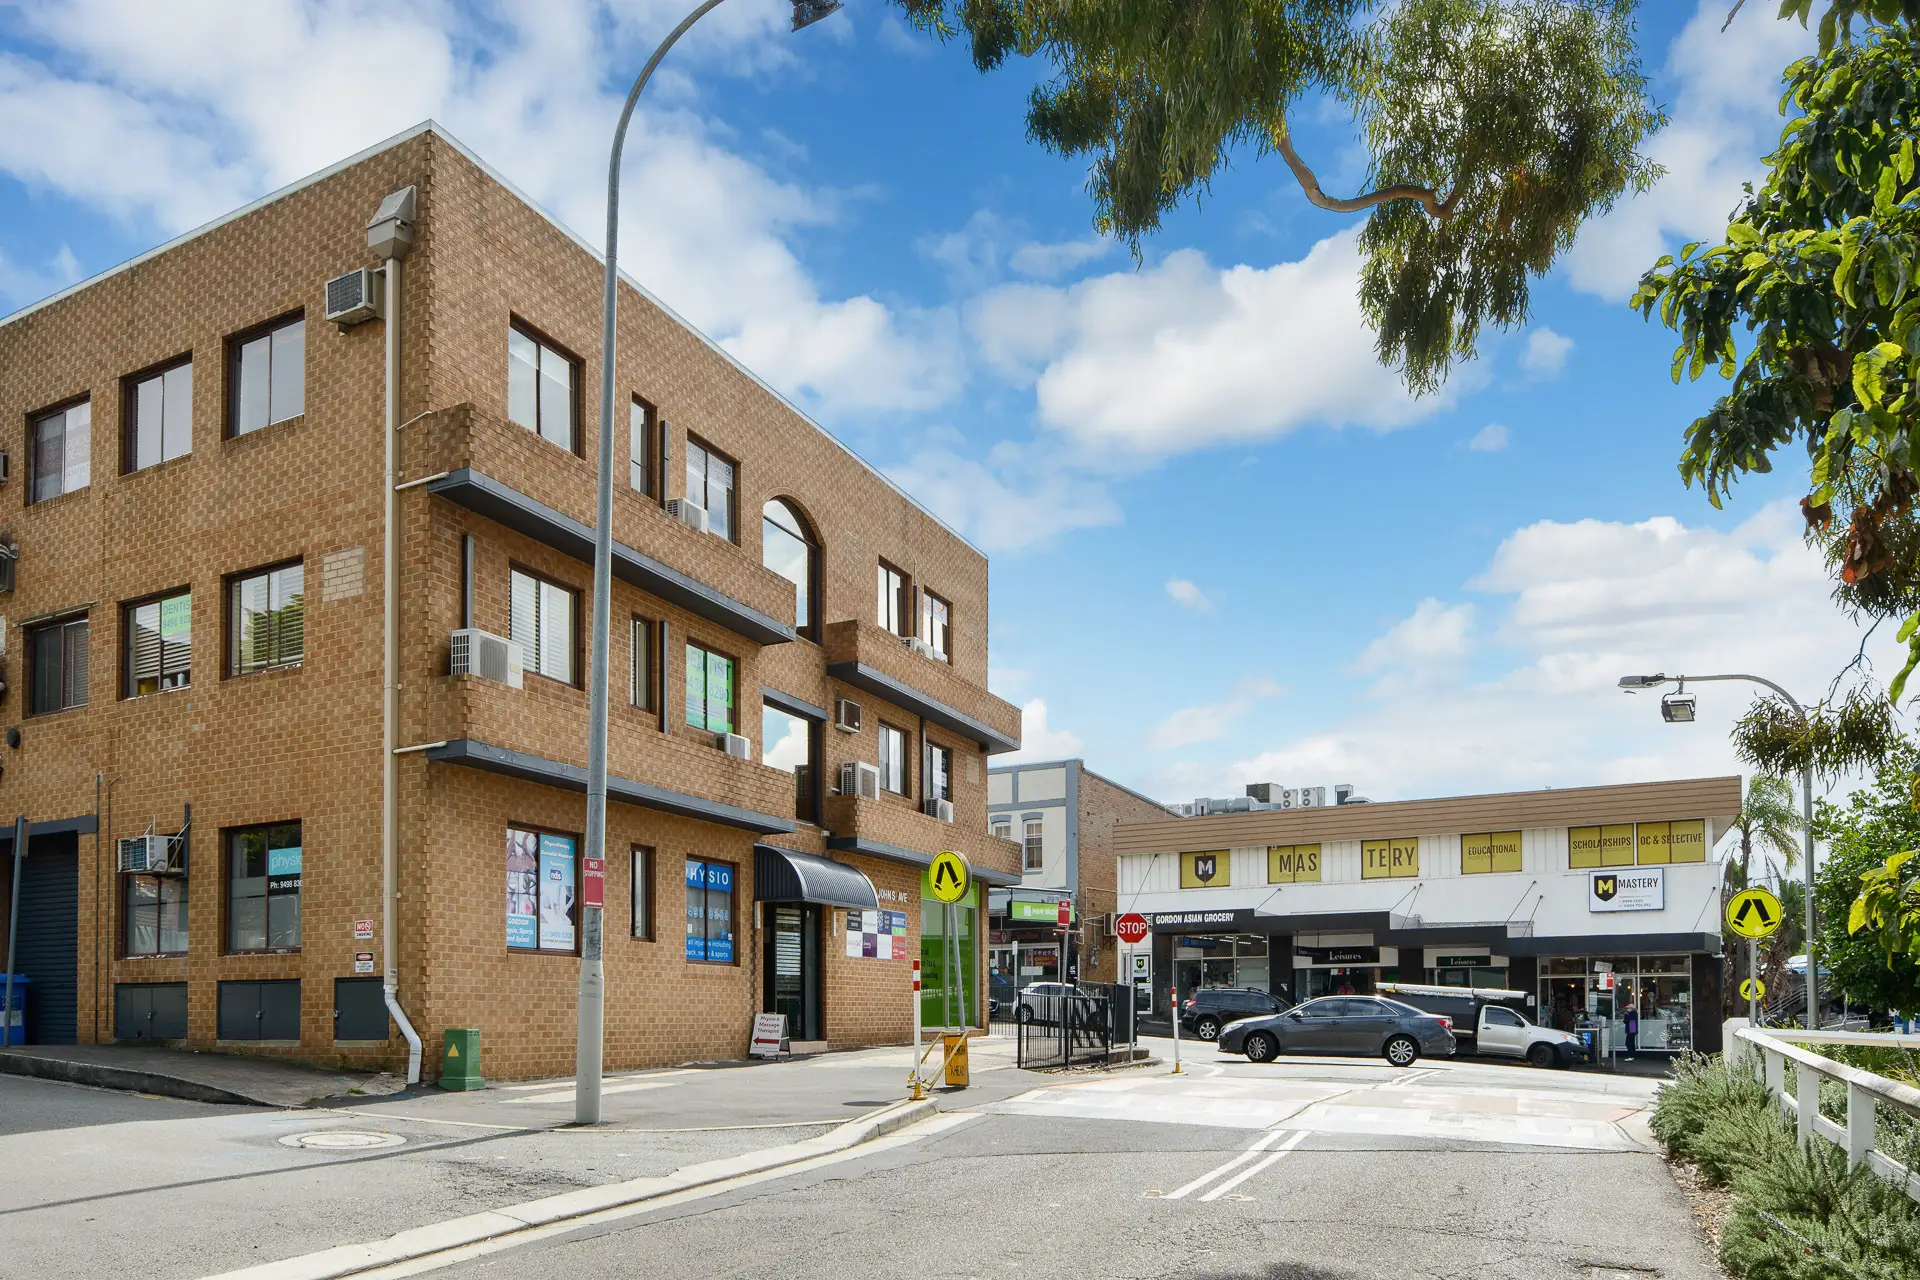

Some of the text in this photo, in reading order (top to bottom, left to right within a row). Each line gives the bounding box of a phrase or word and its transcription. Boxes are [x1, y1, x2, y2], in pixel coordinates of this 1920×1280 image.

[686, 649, 732, 681] ENTIST
[1572, 836, 1631, 850] SCHOLARSHIPS
[1640, 832, 1703, 846] OC & SELECTIVE
[1468, 843, 1518, 857] EDUCATIONAL
[1278, 853, 1318, 873] MAS
[1366, 846, 1416, 869] TERY
[589, 861, 598, 869] NO
[1197, 860, 1214, 876] M
[584, 870, 604, 878] STOPPING
[686, 866, 729, 885] HYSIO
[270, 881, 279, 889] Ph:
[1597, 879, 1614, 894] M
[1618, 877, 1659, 889] MASTERY
[878, 888, 908, 902] JOHNS AVE
[1155, 914, 1183, 925] GORDON
[1183, 913, 1203, 924] ASIAN
[1203, 912, 1235, 923] GROCERY
[1119, 922, 1147, 934] STOP
[1329, 950, 1362, 961] Leisures
[1450, 957, 1477, 965] Leisures
